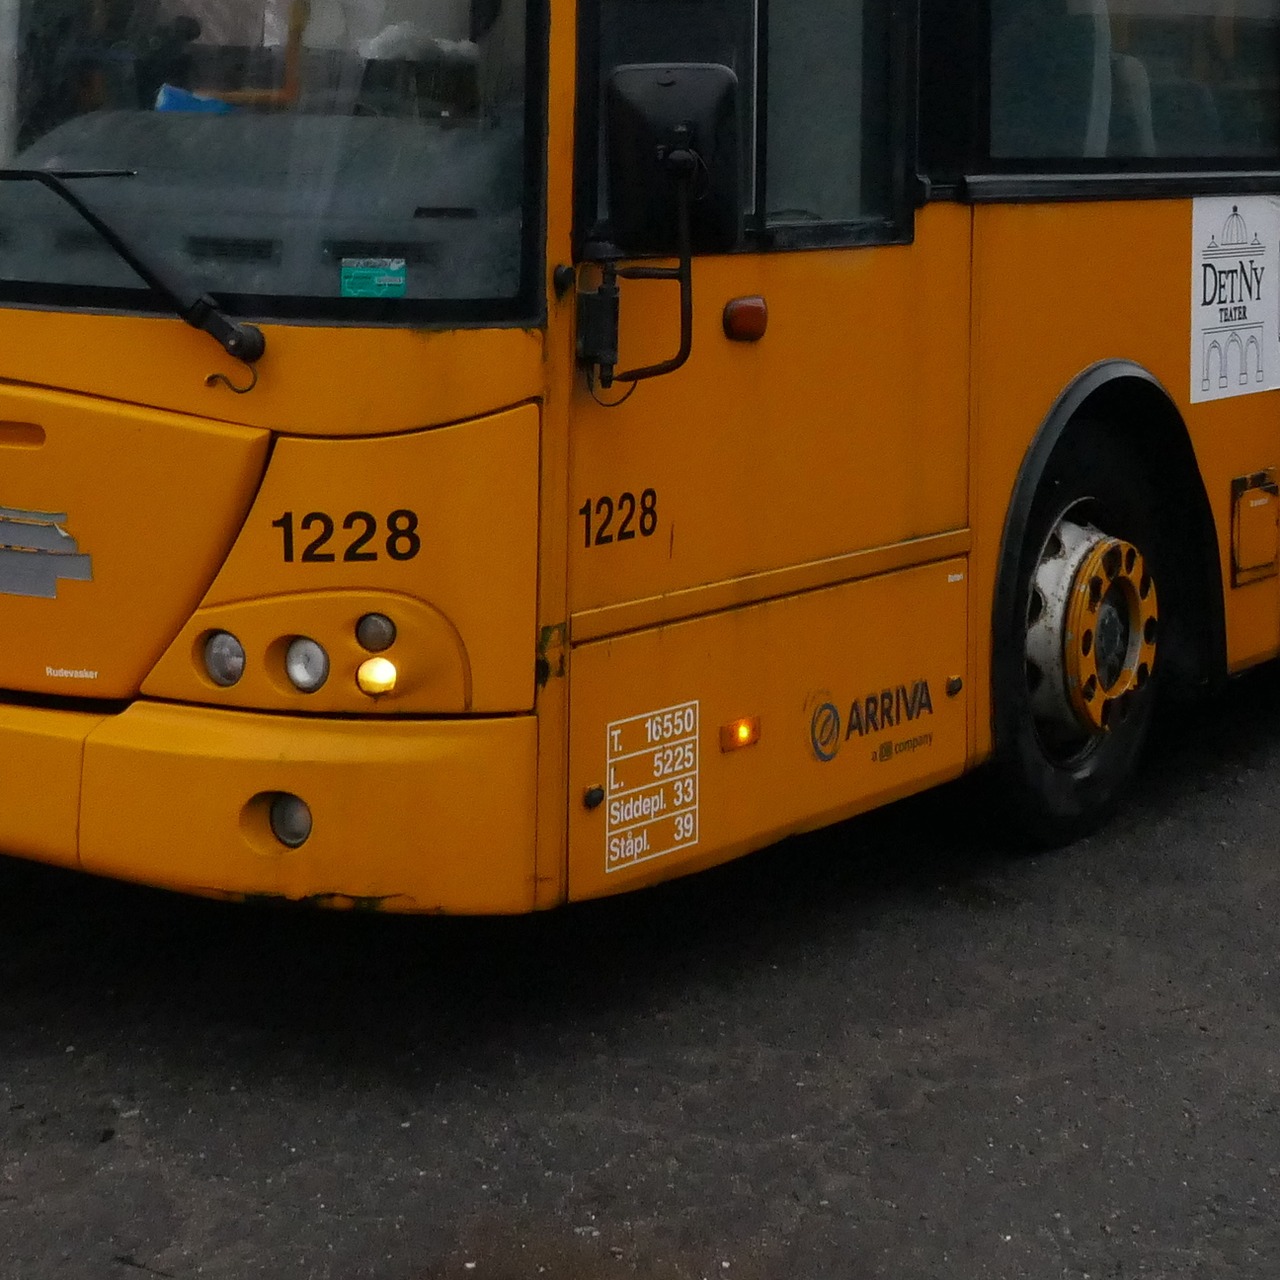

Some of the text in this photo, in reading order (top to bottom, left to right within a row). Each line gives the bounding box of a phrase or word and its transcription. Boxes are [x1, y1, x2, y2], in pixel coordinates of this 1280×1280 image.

[1220, 306, 1248, 323] TEATER
[272, 509, 421, 562] 1228
[579, 487, 658, 548] 1228
[610, 708, 694, 751] T. 16550
[845, 678, 933, 741] ARRIVA
[610, 743, 694, 790] L. 5225
[894, 733, 933, 755] company
[609, 777, 694, 825] Siddepl. 33
[609, 813, 693, 863] Ståpl. 39
